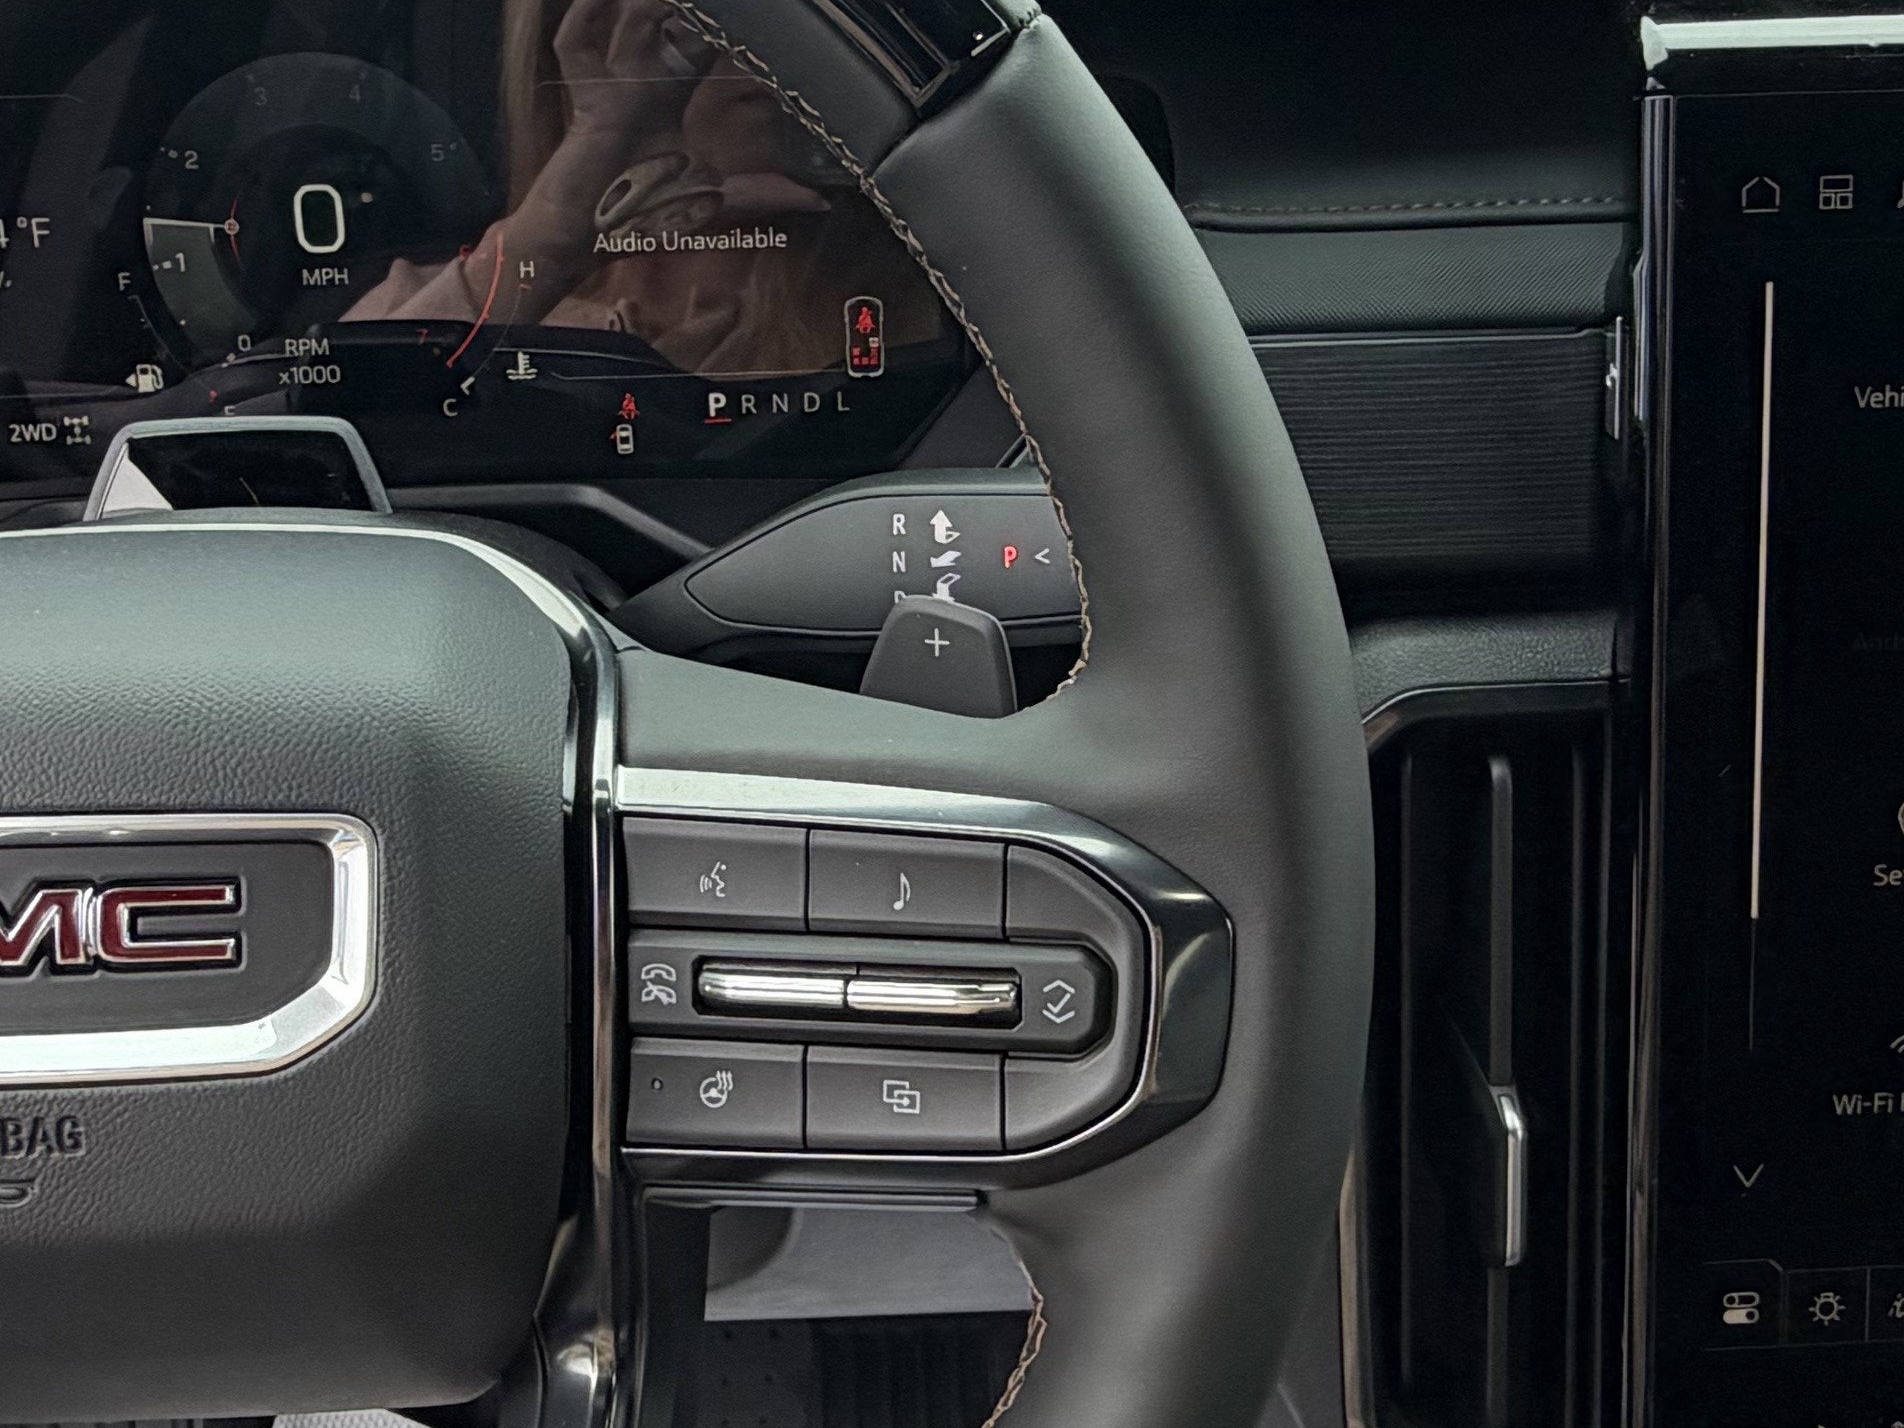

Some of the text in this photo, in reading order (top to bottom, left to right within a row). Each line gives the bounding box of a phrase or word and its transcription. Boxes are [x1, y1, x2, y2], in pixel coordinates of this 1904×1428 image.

[254, 87, 267, 106] 3
[348, 84, 362, 103] 4
[184, 151, 198, 170] 2
[431, 144, 444, 162] 5
[293, 183, 346, 254] 0
[594, 227, 788, 253] Audio Unavailable
[176, 253, 186, 272] 1
[520, 261, 534, 278] H
[118, 273, 131, 291] F
[302, 267, 349, 286] MPH
[283, 338, 330, 357] RPM
[279, 364, 340, 384] x1000
[443, 398, 457, 416] C
[708, 391, 849, 417] P R N D L
[9, 422, 56, 443] 2WD
[892, 514, 905, 535] R
[892, 551, 906, 572] N
[1004, 546, 1017, 568] P
[1833, 1091, 1894, 1115] Wi-Fi
